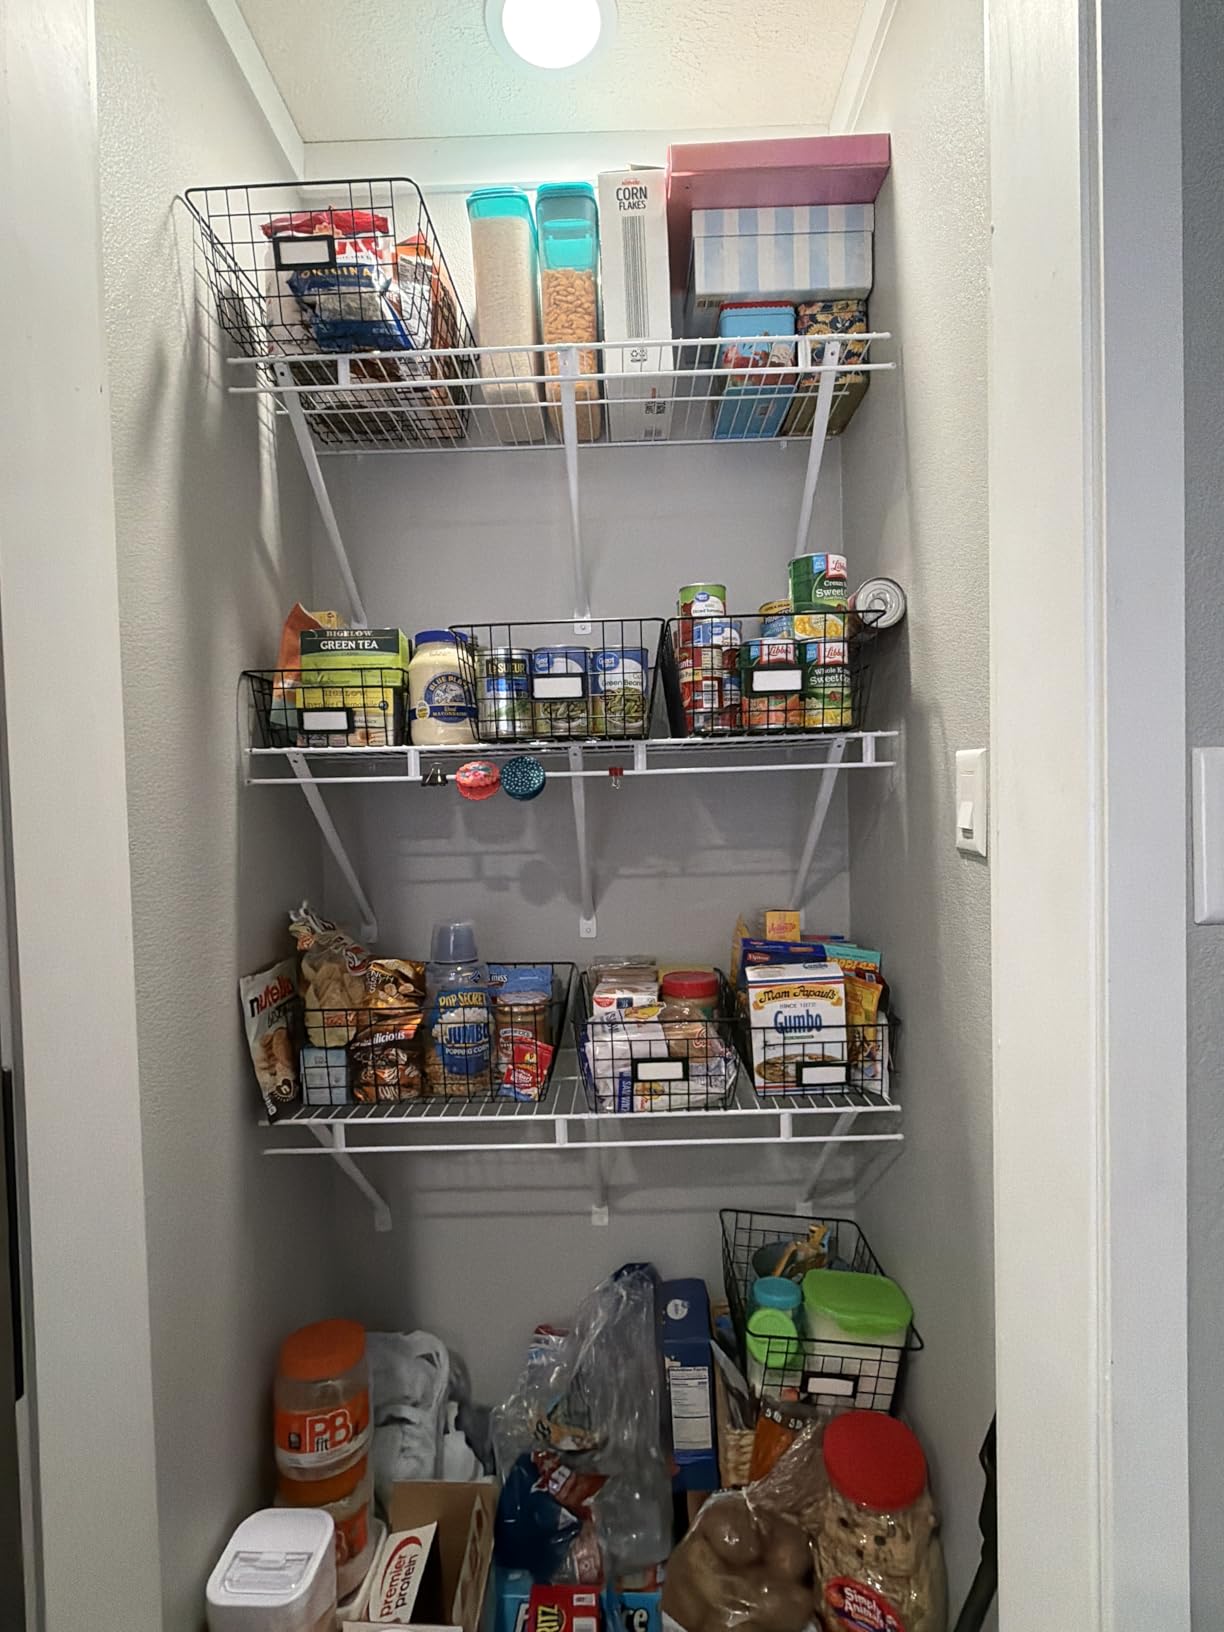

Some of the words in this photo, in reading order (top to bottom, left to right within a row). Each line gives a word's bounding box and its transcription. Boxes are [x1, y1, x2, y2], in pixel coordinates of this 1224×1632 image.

[616, 186, 648, 201] CORN
[618, 200, 647, 212] FLAKES
[300, 266, 373, 280] ORIGINA
[815, 588, 844, 598] Sweet
[326, 629, 373, 637] BIGELOW
[320, 640, 356, 650] GREEN
[358, 640, 379, 650] TEA
[809, 674, 839, 686] Sweet
[758, 990, 790, 1004] Mam
[773, 1008, 823, 1034] Gumbo
[306, 1408, 352, 1452] PB
[380, 1554, 406, 1618] premier
[395, 1553, 419, 1610] protein
